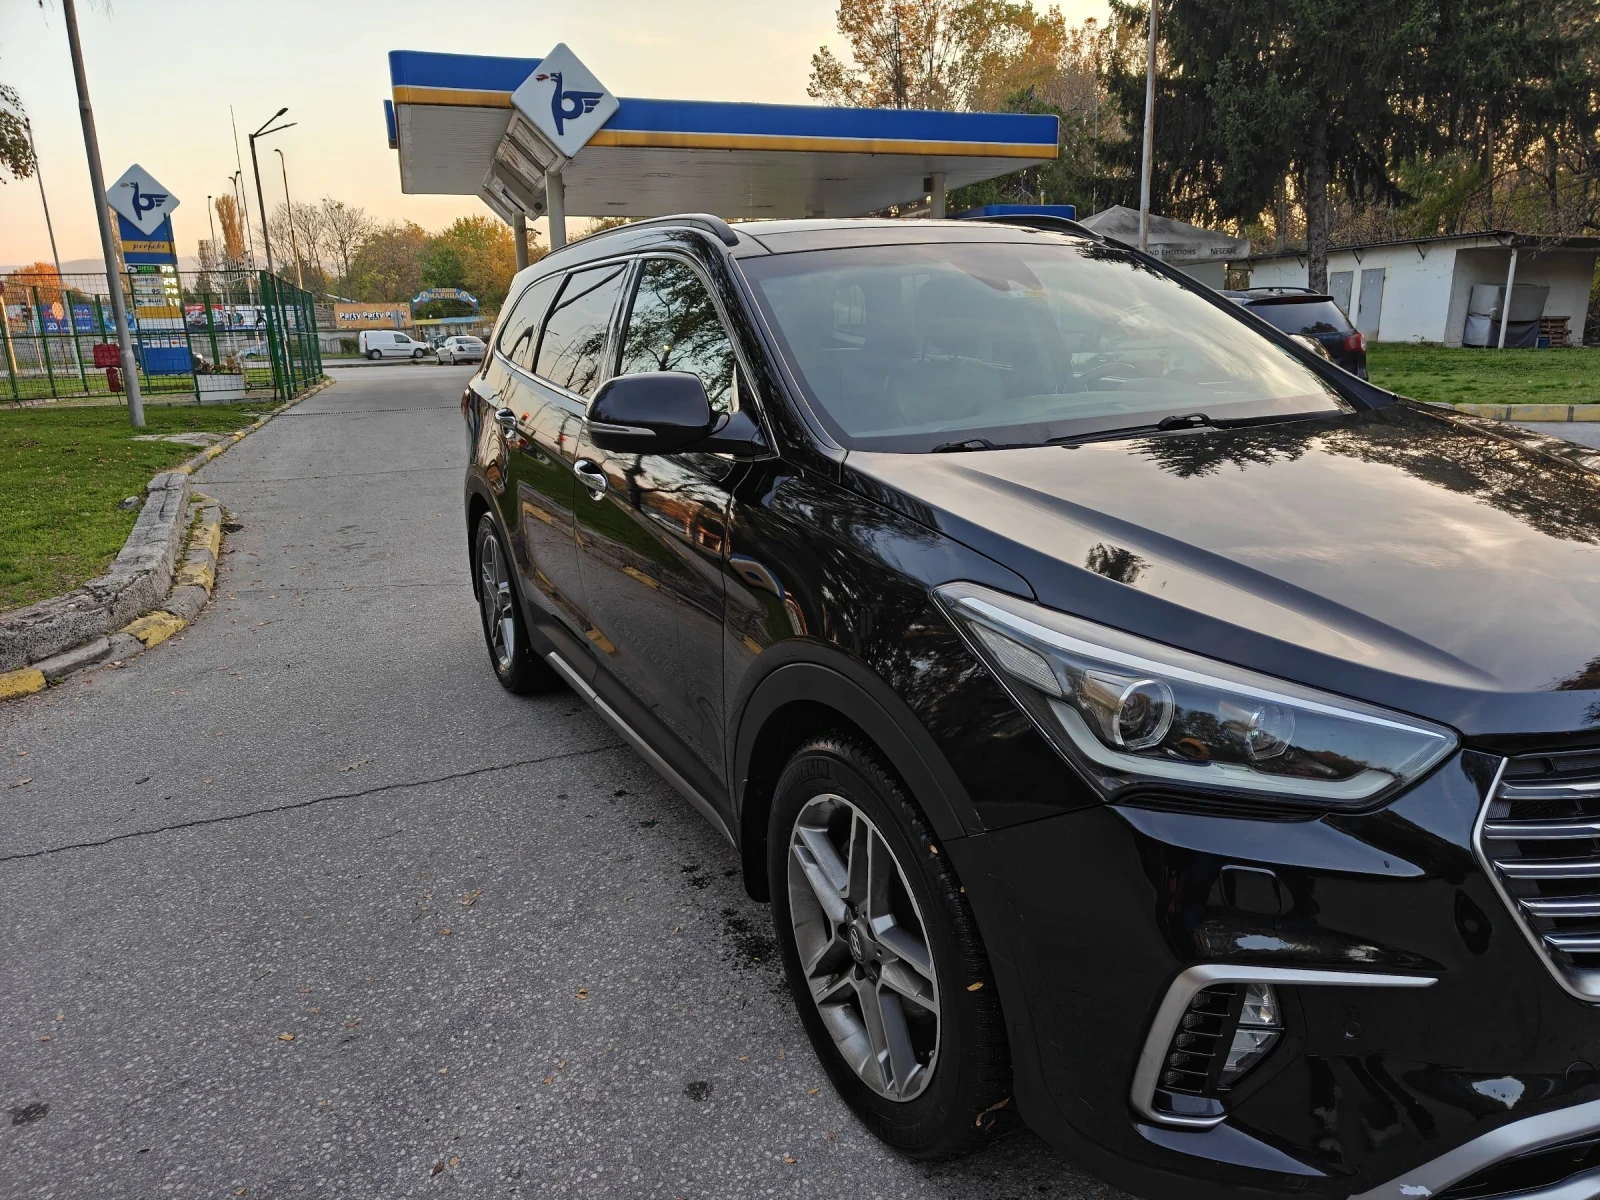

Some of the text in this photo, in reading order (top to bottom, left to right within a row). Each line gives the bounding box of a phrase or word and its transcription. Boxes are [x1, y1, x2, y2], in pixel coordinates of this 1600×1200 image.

[1162, 248, 1196, 256] EMOTIONS
[339, 311, 361, 320] Party
[362, 311, 384, 320] Party
